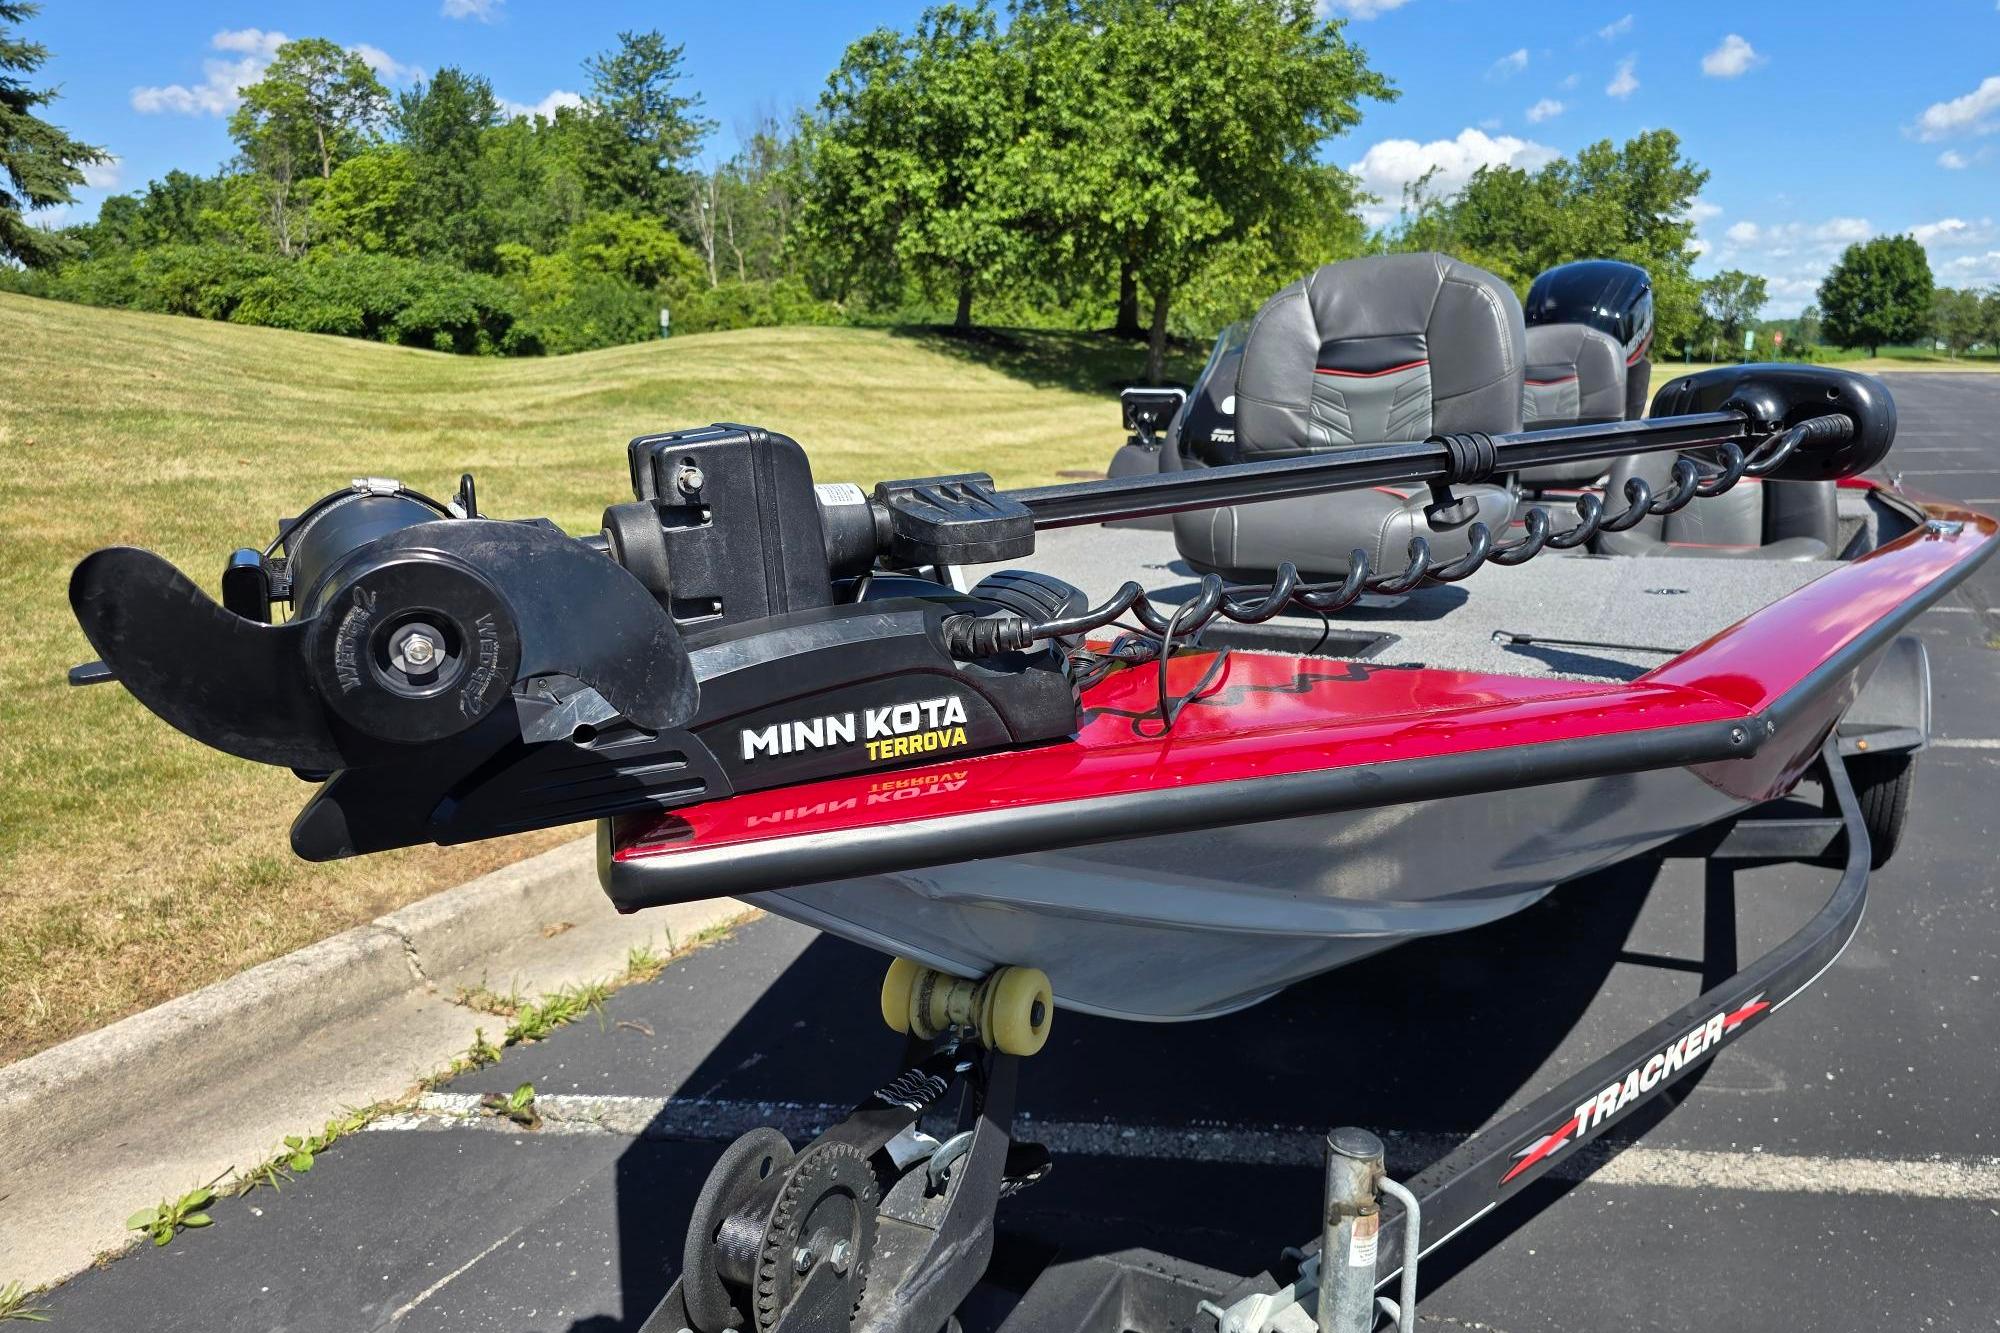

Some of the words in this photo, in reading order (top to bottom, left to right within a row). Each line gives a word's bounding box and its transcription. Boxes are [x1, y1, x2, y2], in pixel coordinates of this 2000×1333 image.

[742, 713, 855, 760] MINN
[865, 696, 968, 739] KOTA
[865, 728, 968, 761] TERROVA
[1573, 1012, 1726, 1138] TRACKER
